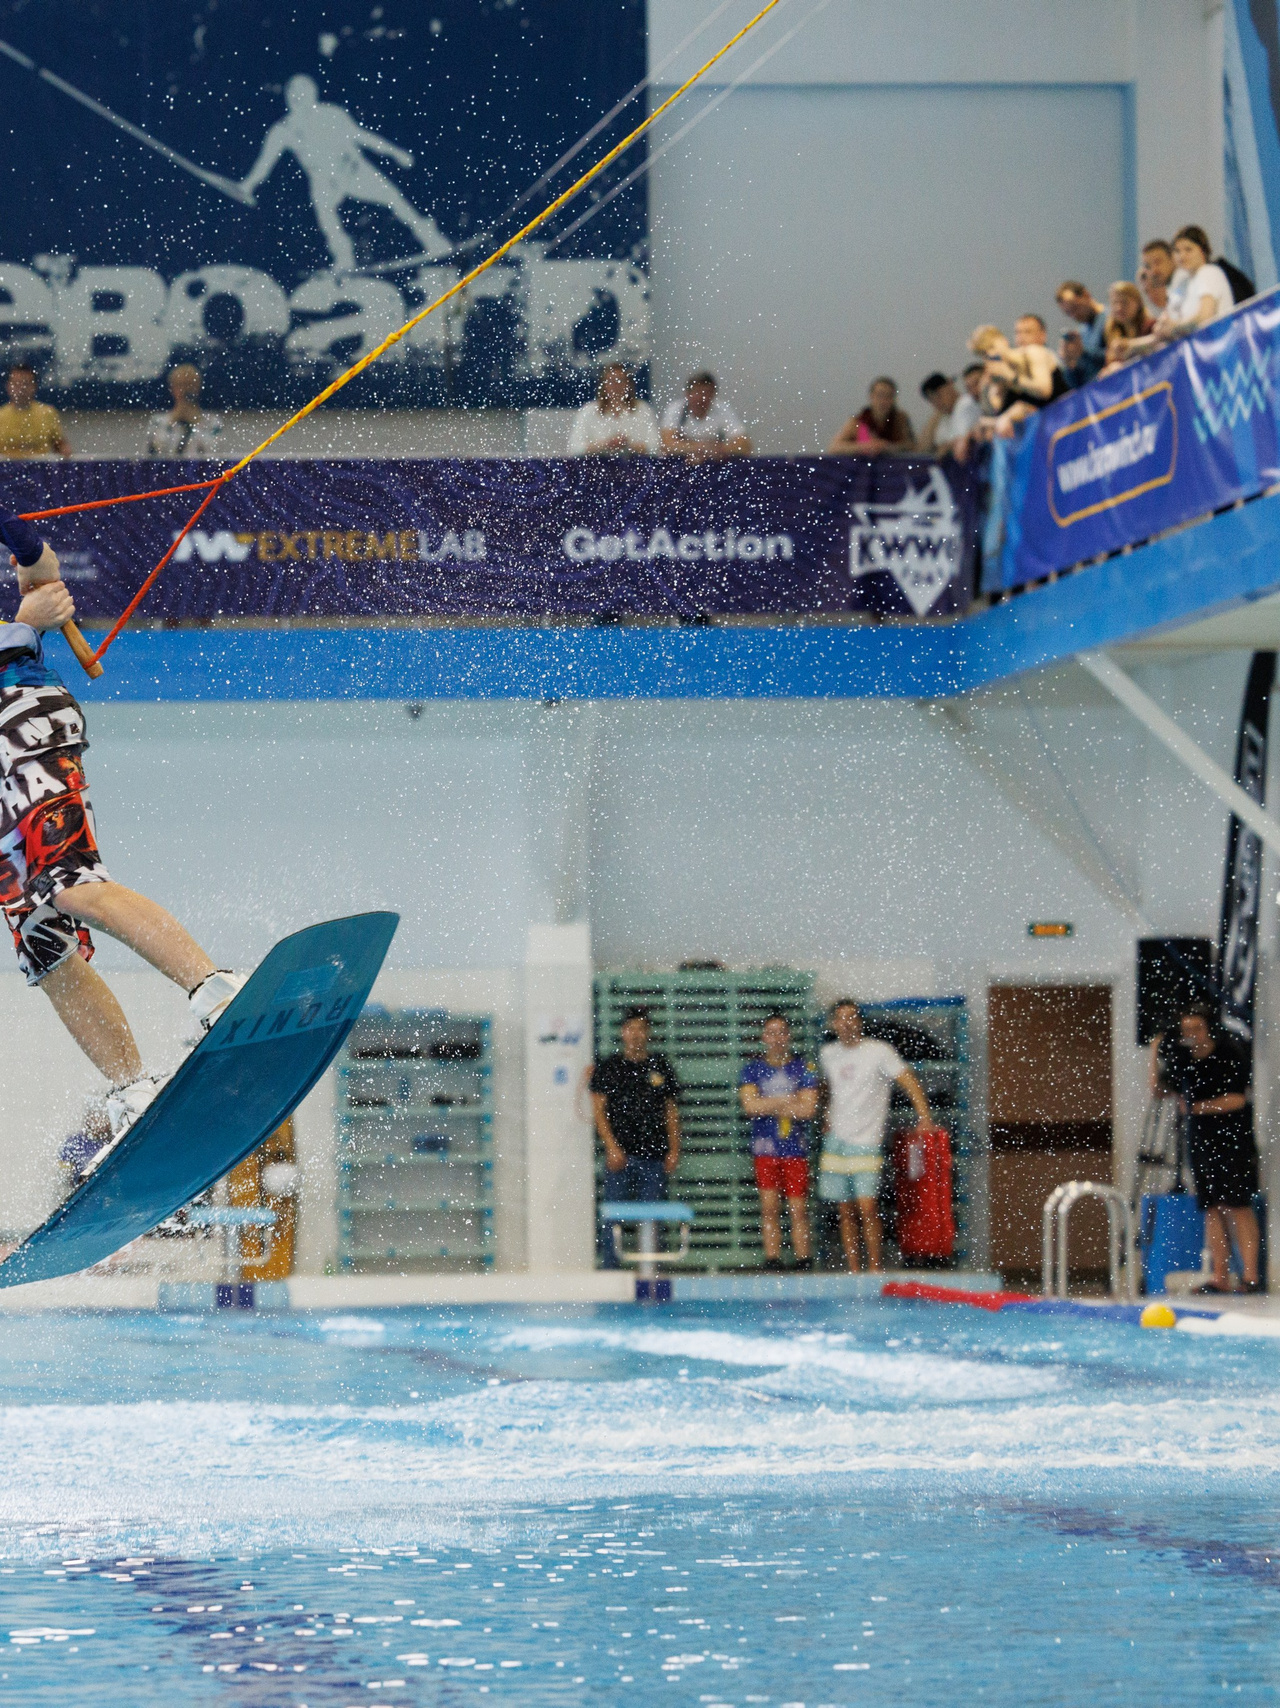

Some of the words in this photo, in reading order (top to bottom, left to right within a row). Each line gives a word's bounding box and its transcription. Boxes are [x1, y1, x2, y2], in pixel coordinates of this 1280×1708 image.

[257, 529, 486, 563] EXTREMELAB
[563, 526, 794, 561] GetAction
[220, 993, 355, 1046] RONIX
